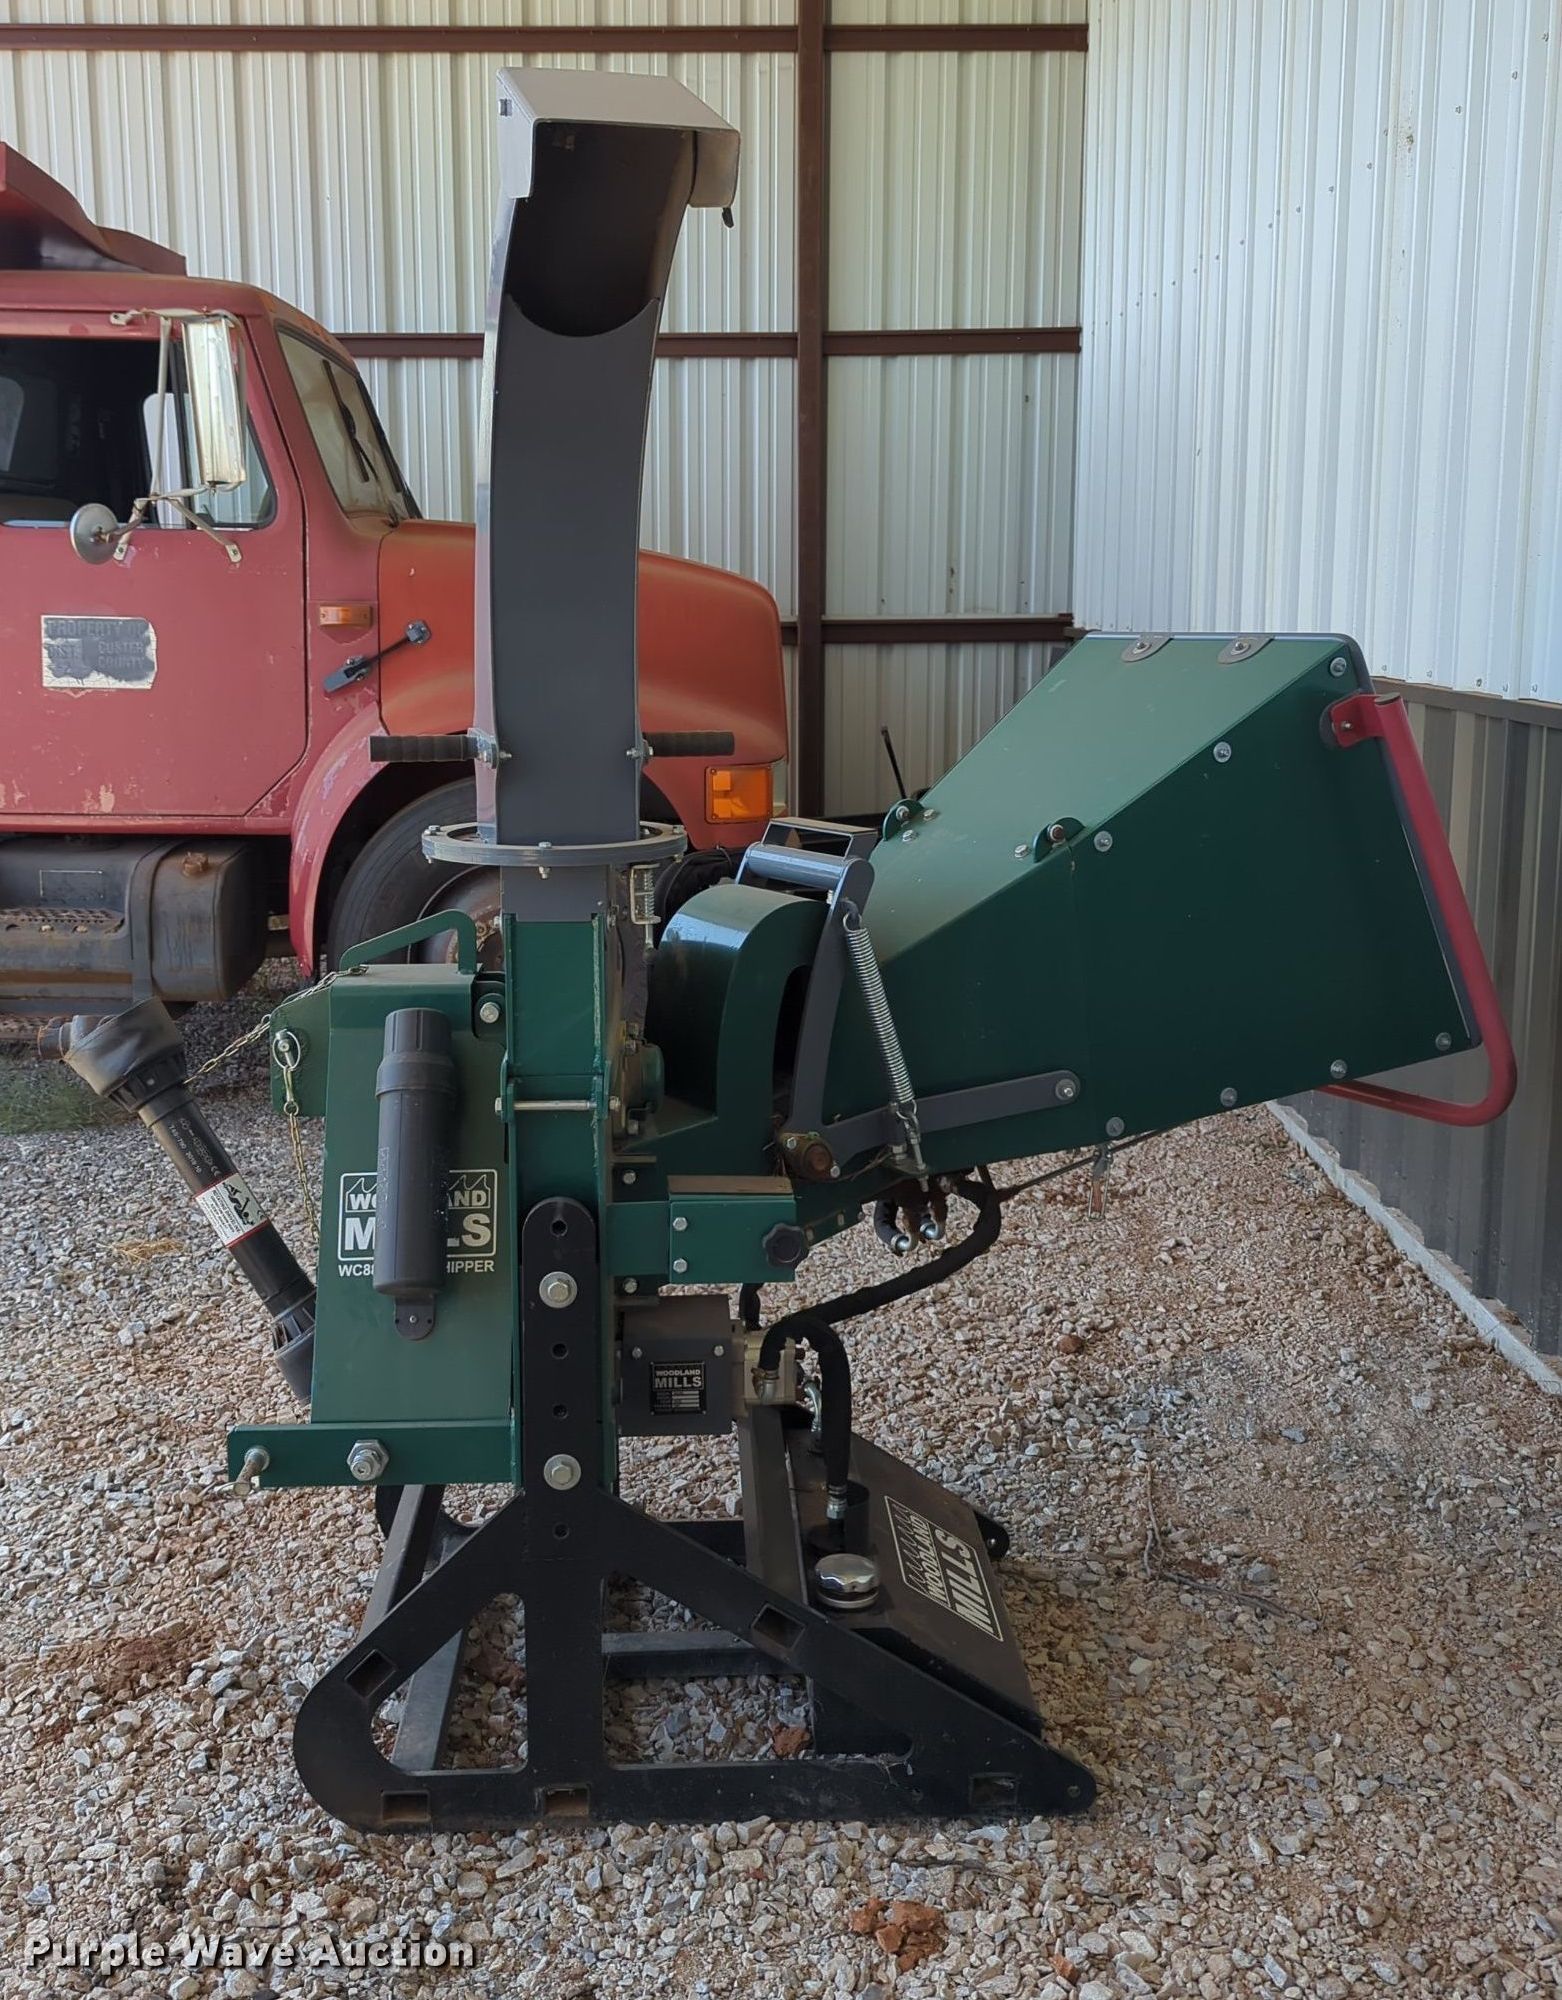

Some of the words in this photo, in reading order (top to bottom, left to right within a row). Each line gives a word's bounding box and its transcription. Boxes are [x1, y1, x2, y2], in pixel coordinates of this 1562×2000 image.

[655, 1376, 701, 1388] MILLS
[910, 1515, 947, 1601] WOODLAND
[934, 1529, 994, 1634] MILLS
